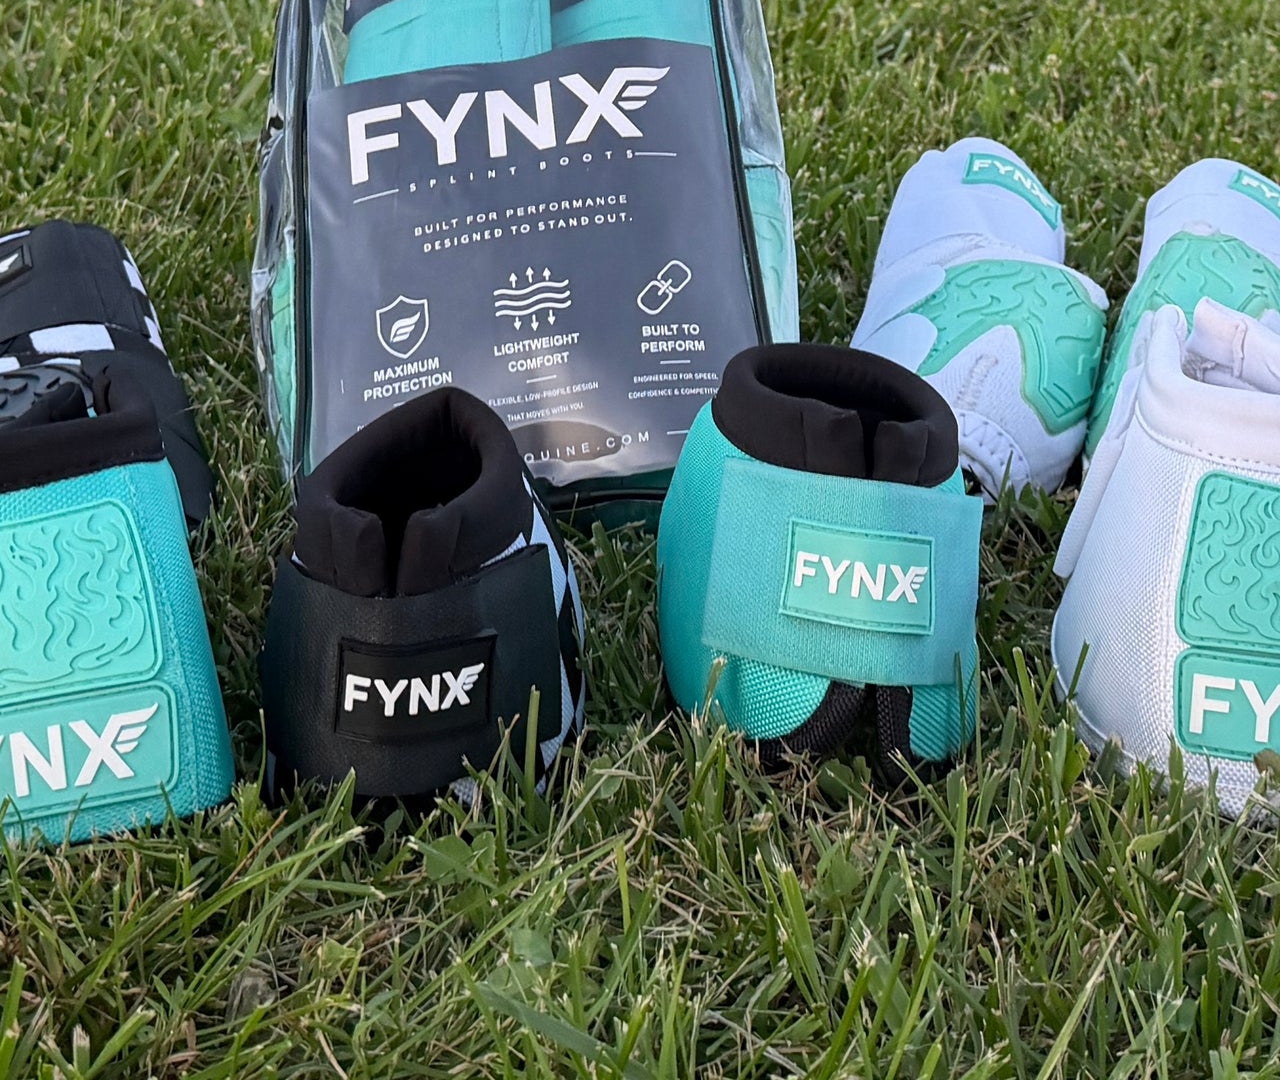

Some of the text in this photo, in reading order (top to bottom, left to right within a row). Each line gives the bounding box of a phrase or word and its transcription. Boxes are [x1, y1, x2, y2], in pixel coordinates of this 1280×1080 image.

[346, 66, 671, 186] FYNX
[409, 149, 634, 193] SPLINT BOOTS
[972, 158, 1055, 210] FYNX
[414, 194, 628, 237] BUILT FOR PERFORMANCE
[423, 227, 503, 253] DESIGNED
[510, 223, 531, 236] TO
[641, 323, 700, 337] BUILT TO
[493, 332, 580, 357] LIGHTWEIGHT
[640, 339, 706, 354] PERFORM
[373, 356, 440, 383] MAXIMUM
[507, 351, 570, 373] COMFORT
[363, 371, 453, 402] PROTECTION
[572, 381, 599, 393] DESIGN
[633, 373, 678, 384] ENGINEERED
[679, 372, 694, 380] FOR
[628, 388, 672, 400] CONFIDENCE
[680, 386, 719, 396] COMPETITIV
[506, 411, 525, 423] THAT
[526, 408, 551, 420] MOVES
[551, 405, 569, 417] WITH
[523, 430, 650, 464] QUINE.COM
[792, 550, 929, 604] FYNX
[343, 662, 485, 717] FYNX
